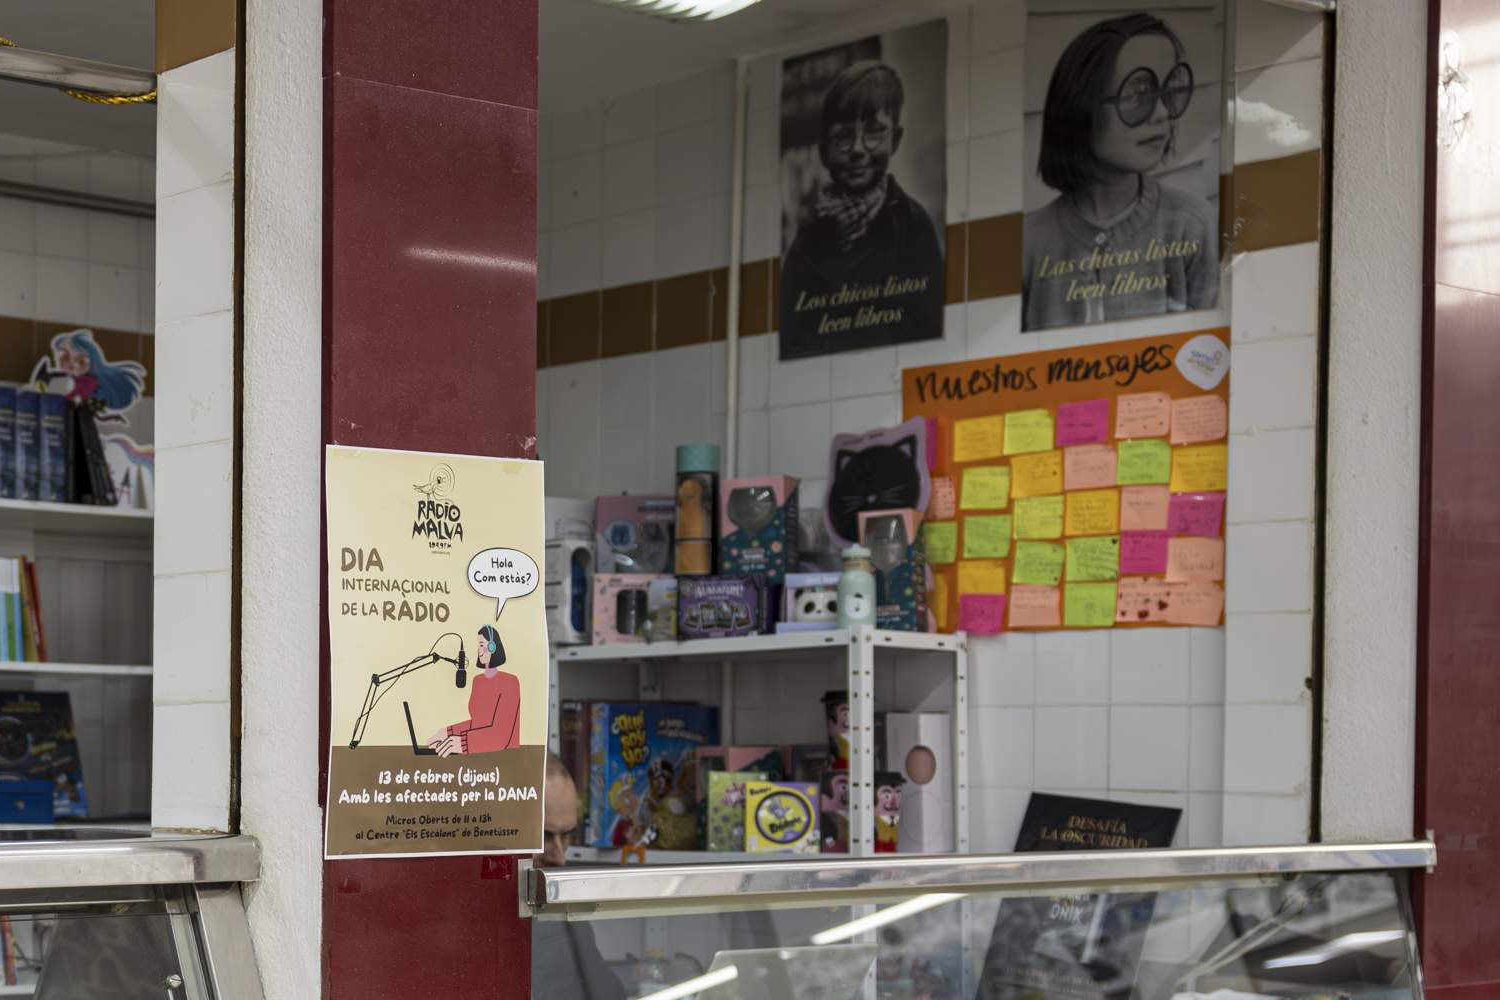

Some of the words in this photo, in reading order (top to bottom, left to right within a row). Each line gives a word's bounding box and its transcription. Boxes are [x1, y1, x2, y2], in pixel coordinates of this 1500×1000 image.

[1038, 254, 1075, 280] Las
[1079, 242, 1140, 272] chicas
[1146, 238, 1200, 264] listas
[830, 281, 879, 306] chicos
[883, 275, 929, 300] listos
[1066, 279, 1106, 303] leen
[1111, 271, 1170, 298] libros
[818, 312, 851, 335] leen
[855, 303, 904, 329] libros
[1049, 345, 1174, 386] mensajes
[412, 518, 463, 542] MALVA
[340, 547, 384, 572] DIA
[491, 557, 514, 569] Hola
[341, 578, 451, 595] INTERNACIONAL
[473, 570, 497, 584] Com
[499, 571, 532, 586] estàs?
[341, 602, 358, 616] DE
[362, 602, 379, 616] LA
[382, 592, 451, 623] RÀDIO
[378, 770, 392, 785] 13
[395, 768, 410, 785] de
[413, 768, 455, 784] febrer
[457, 766, 500, 788] (dijous)
[338, 788, 370, 805] Amb
[373, 789, 392, 804] les
[395, 787, 458, 804] afectades
[461, 790, 481, 807] per
[484, 787, 495, 801] la
[497, 786, 538, 802] DANA
[385, 814, 416, 826] Micros
[418, 813, 449, 825] Oberts
[451, 813, 462, 824] de
[479, 813, 492, 823] 13h
[355, 829, 364, 840] al
[366, 829, 399, 841] Centre
[462, 827, 472, 837] de
[1041, 828, 1061, 842] LA
[1060, 829, 1148, 849] OSCURIDAD
